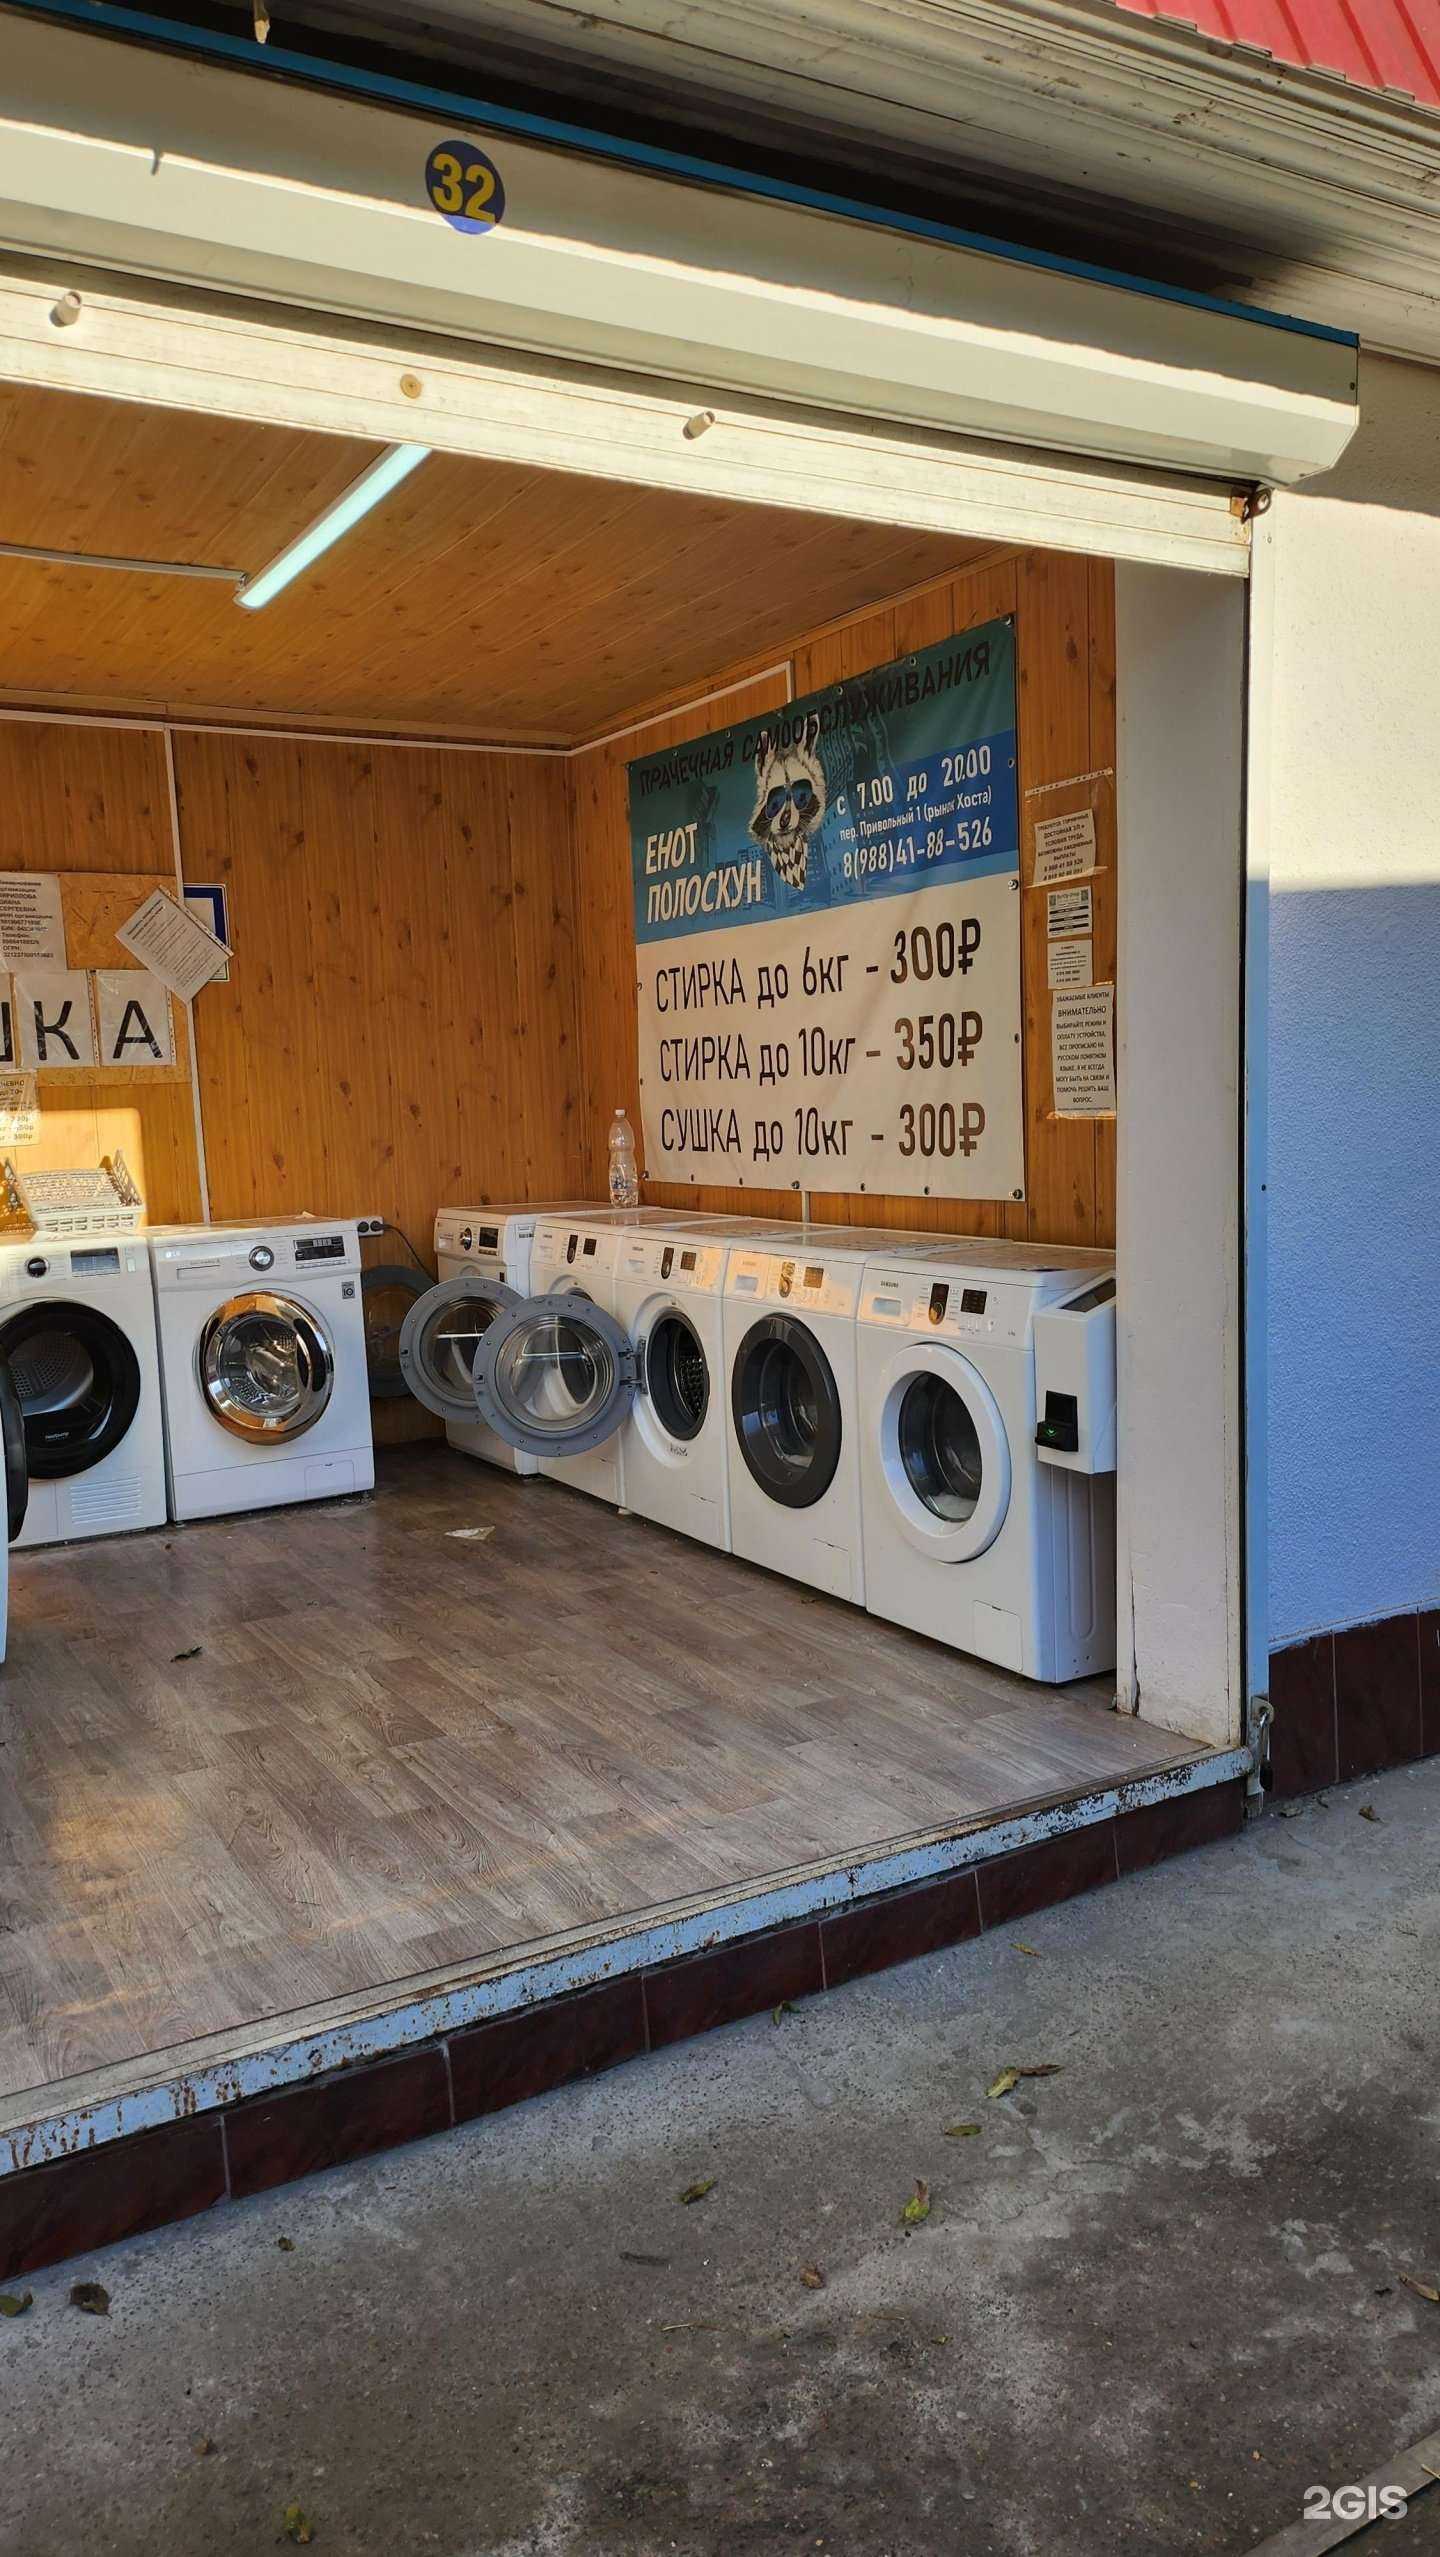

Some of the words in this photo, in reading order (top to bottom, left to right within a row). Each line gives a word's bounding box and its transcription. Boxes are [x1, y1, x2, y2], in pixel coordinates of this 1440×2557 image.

[432, 153, 496, 224] 32
[640, 740, 734, 796] ПРАЧЕЧНАЯ
[742, 641, 991, 762] САМООБСЛУЖИВАНИЯ
[857, 775, 894, 810] 7.00
[907, 772, 928, 802] до
[941, 745, 992, 787] 20.00
[839, 827, 859, 842] пер.
[859, 808, 914, 839] Привольный
[916, 806, 922, 821] 1
[924, 801, 955, 823] (рынок
[956, 785, 993, 810] Хоста)
[645, 822, 698, 875] ЕНОТ
[647, 860, 761, 924] ПОЛОСКУН
[655, 957, 746, 1013] СТИРКА
[757, 963, 789, 1010] до
[802, 946, 849, 997] 6кг
[890, 918, 982, 984] 300₽
[1057, 1005, 1107, 1017] ВНИМАТЕЛЬНО
[659, 1033, 751, 1083] СТИРКА
[759, 1042, 790, 1086] до
[798, 1026, 856, 1077] 10кг
[894, 1010, 984, 1070] 350₽
[660, 1108, 742, 1154] СУШКА
[753, 1120, 784, 1162] до
[794, 1107, 853, 1156] 10кг
[898, 1102, 986, 1158] 300₽
